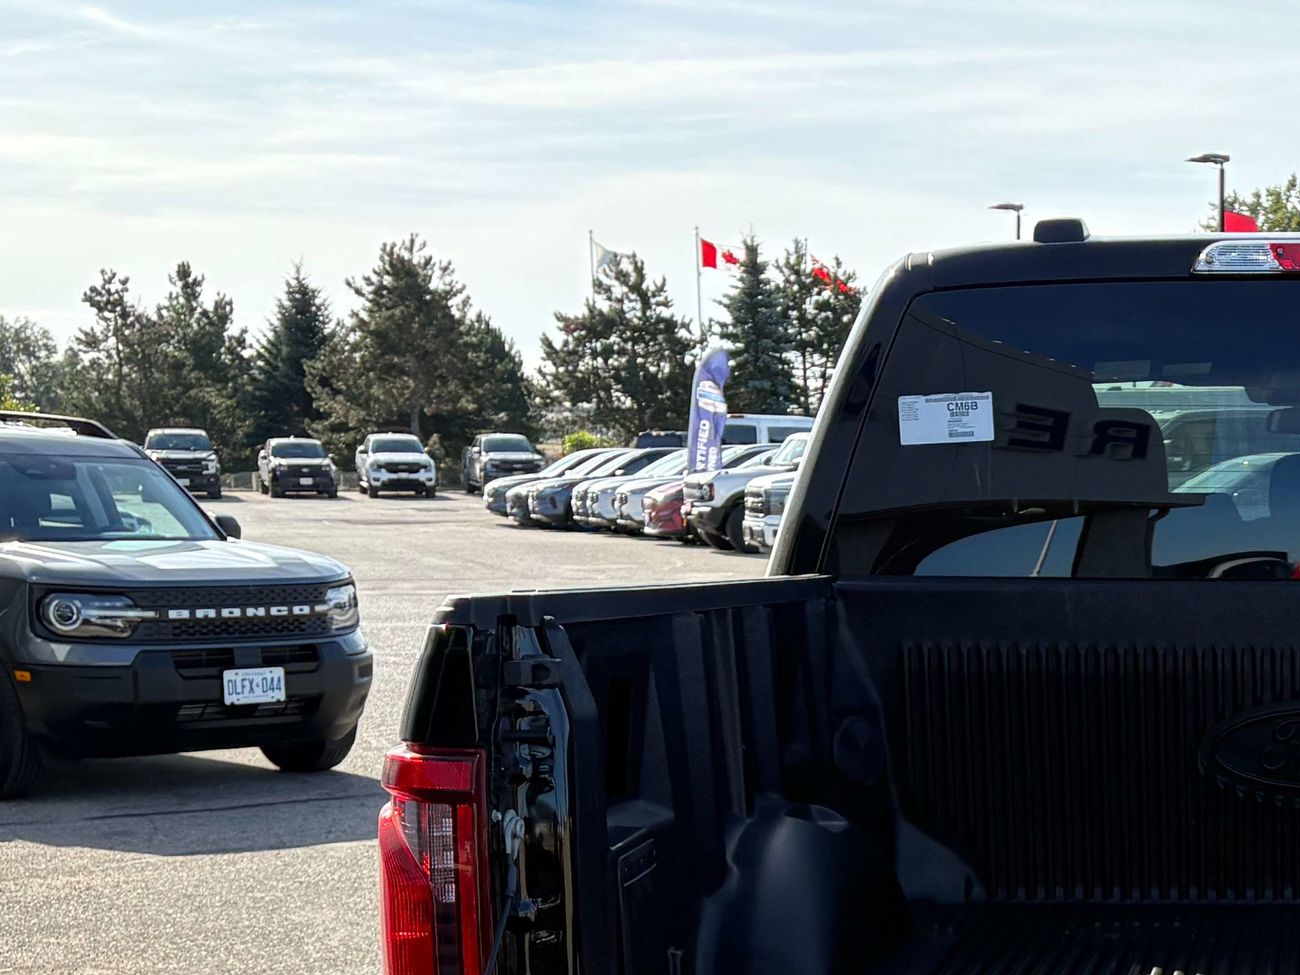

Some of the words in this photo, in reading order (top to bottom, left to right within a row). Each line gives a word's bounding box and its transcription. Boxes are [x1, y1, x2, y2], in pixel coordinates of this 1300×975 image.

[946, 401, 978, 412] CM6B
[696, 419, 710, 471] RTIFIED
[168, 605, 310, 619] BRONCO
[227, 678, 255, 696] DLFX
